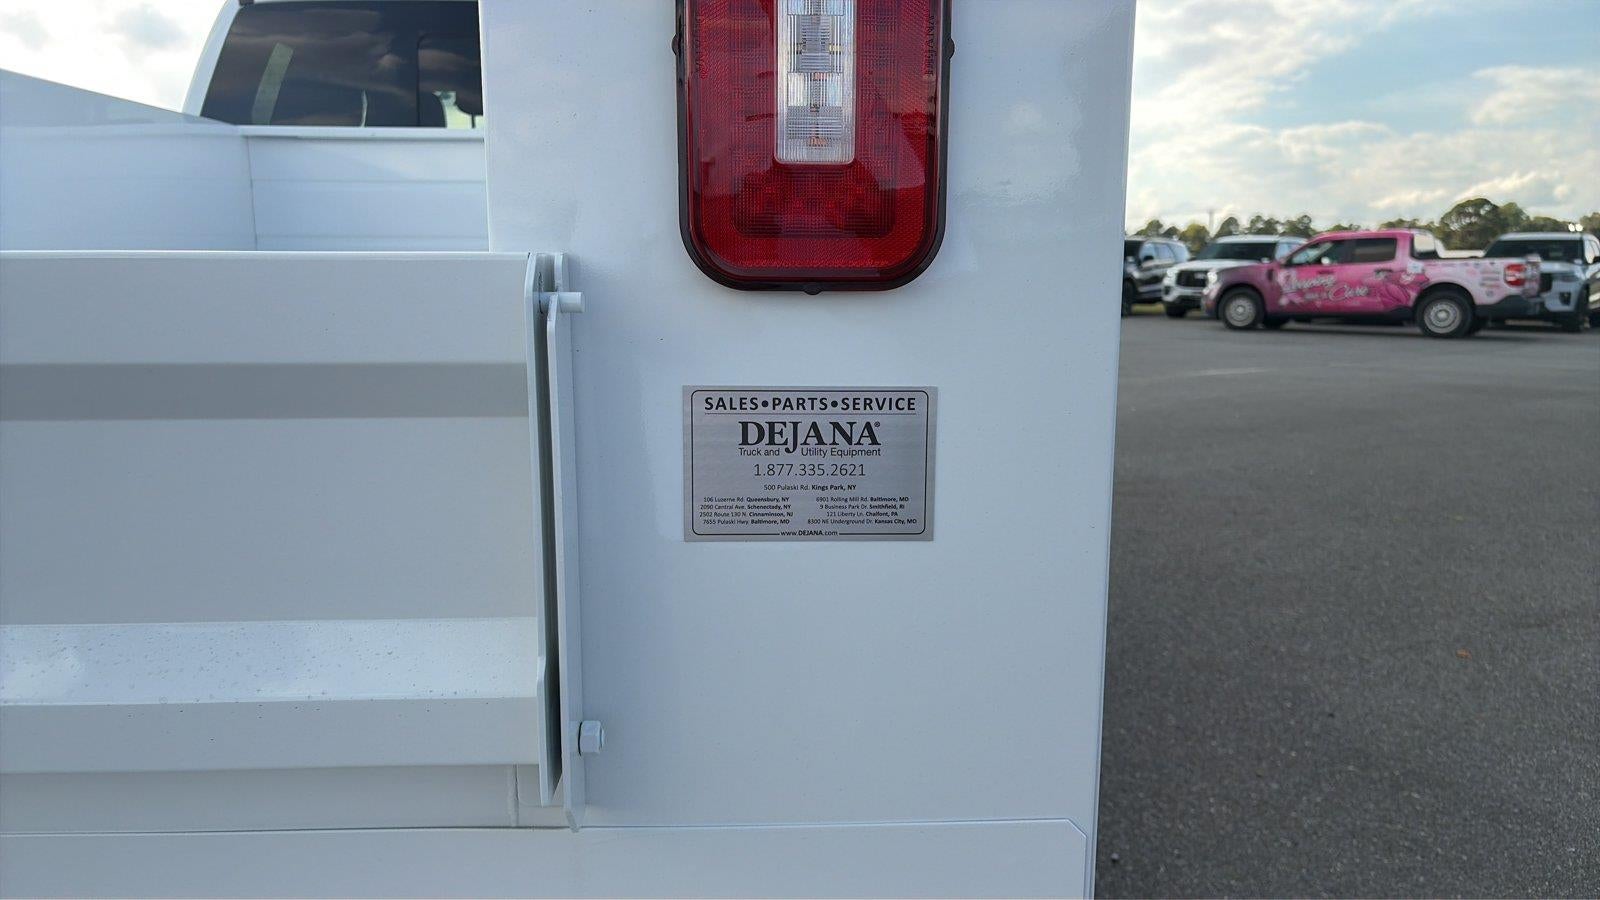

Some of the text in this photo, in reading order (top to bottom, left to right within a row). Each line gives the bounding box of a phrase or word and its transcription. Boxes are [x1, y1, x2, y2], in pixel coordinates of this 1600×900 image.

[704, 397, 916, 411] SALES PARTS SERVICE
[739, 447, 880, 458] Truck and Utility Equipment
[754, 463, 866, 476] 1.877.335.2621
